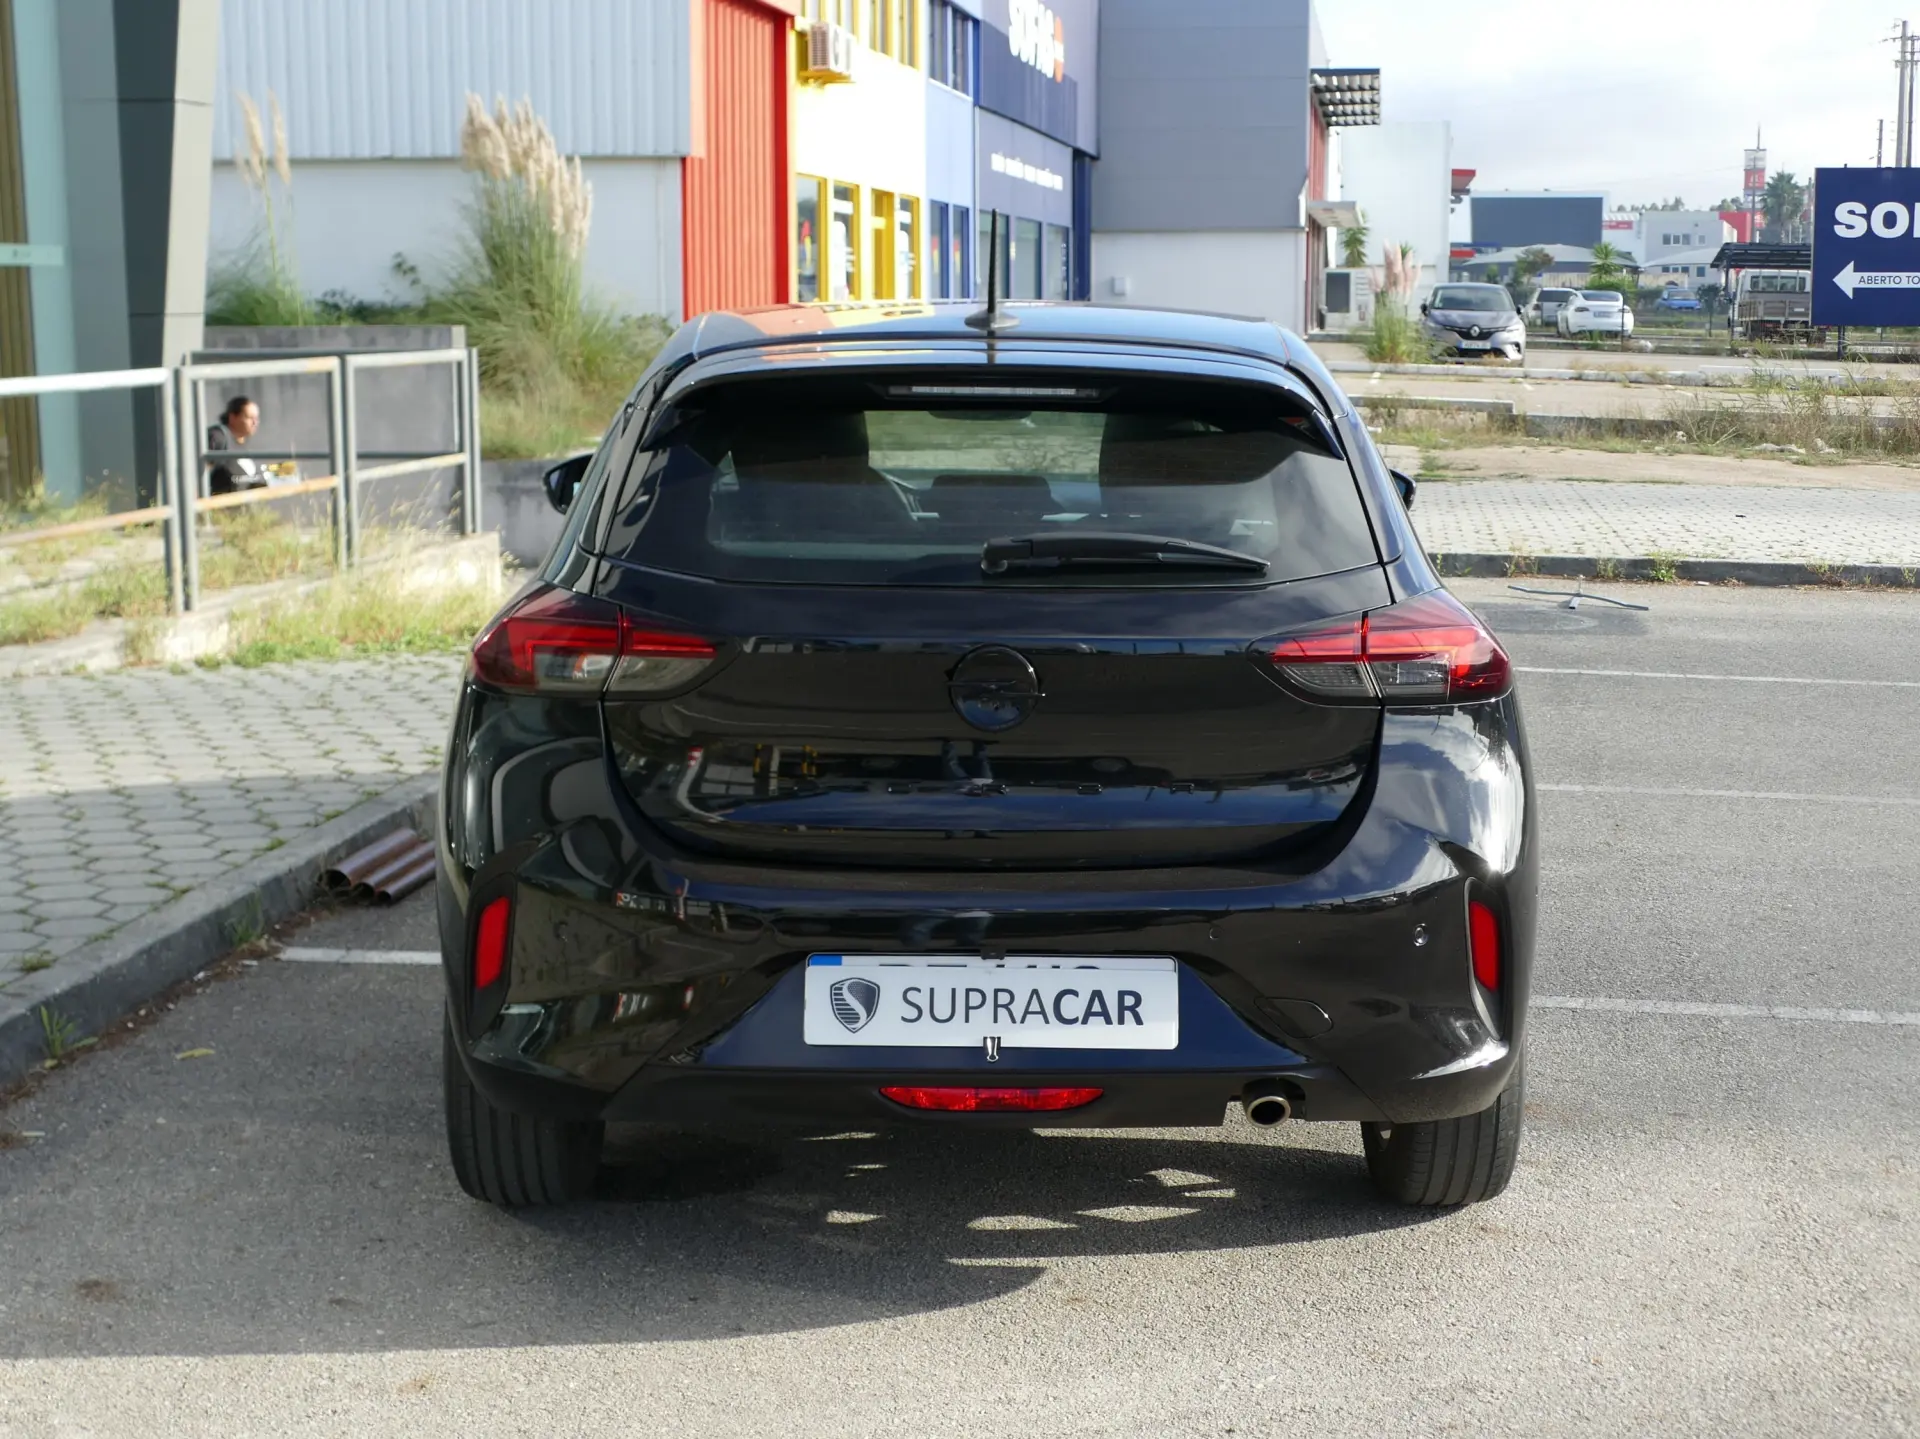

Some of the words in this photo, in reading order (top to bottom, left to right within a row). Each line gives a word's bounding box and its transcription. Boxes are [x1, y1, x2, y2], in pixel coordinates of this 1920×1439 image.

[1833, 201, 1920, 238] SO
[1858, 275, 1902, 285] ABERTO
[900, 986, 1144, 1026] SUPRACAR
